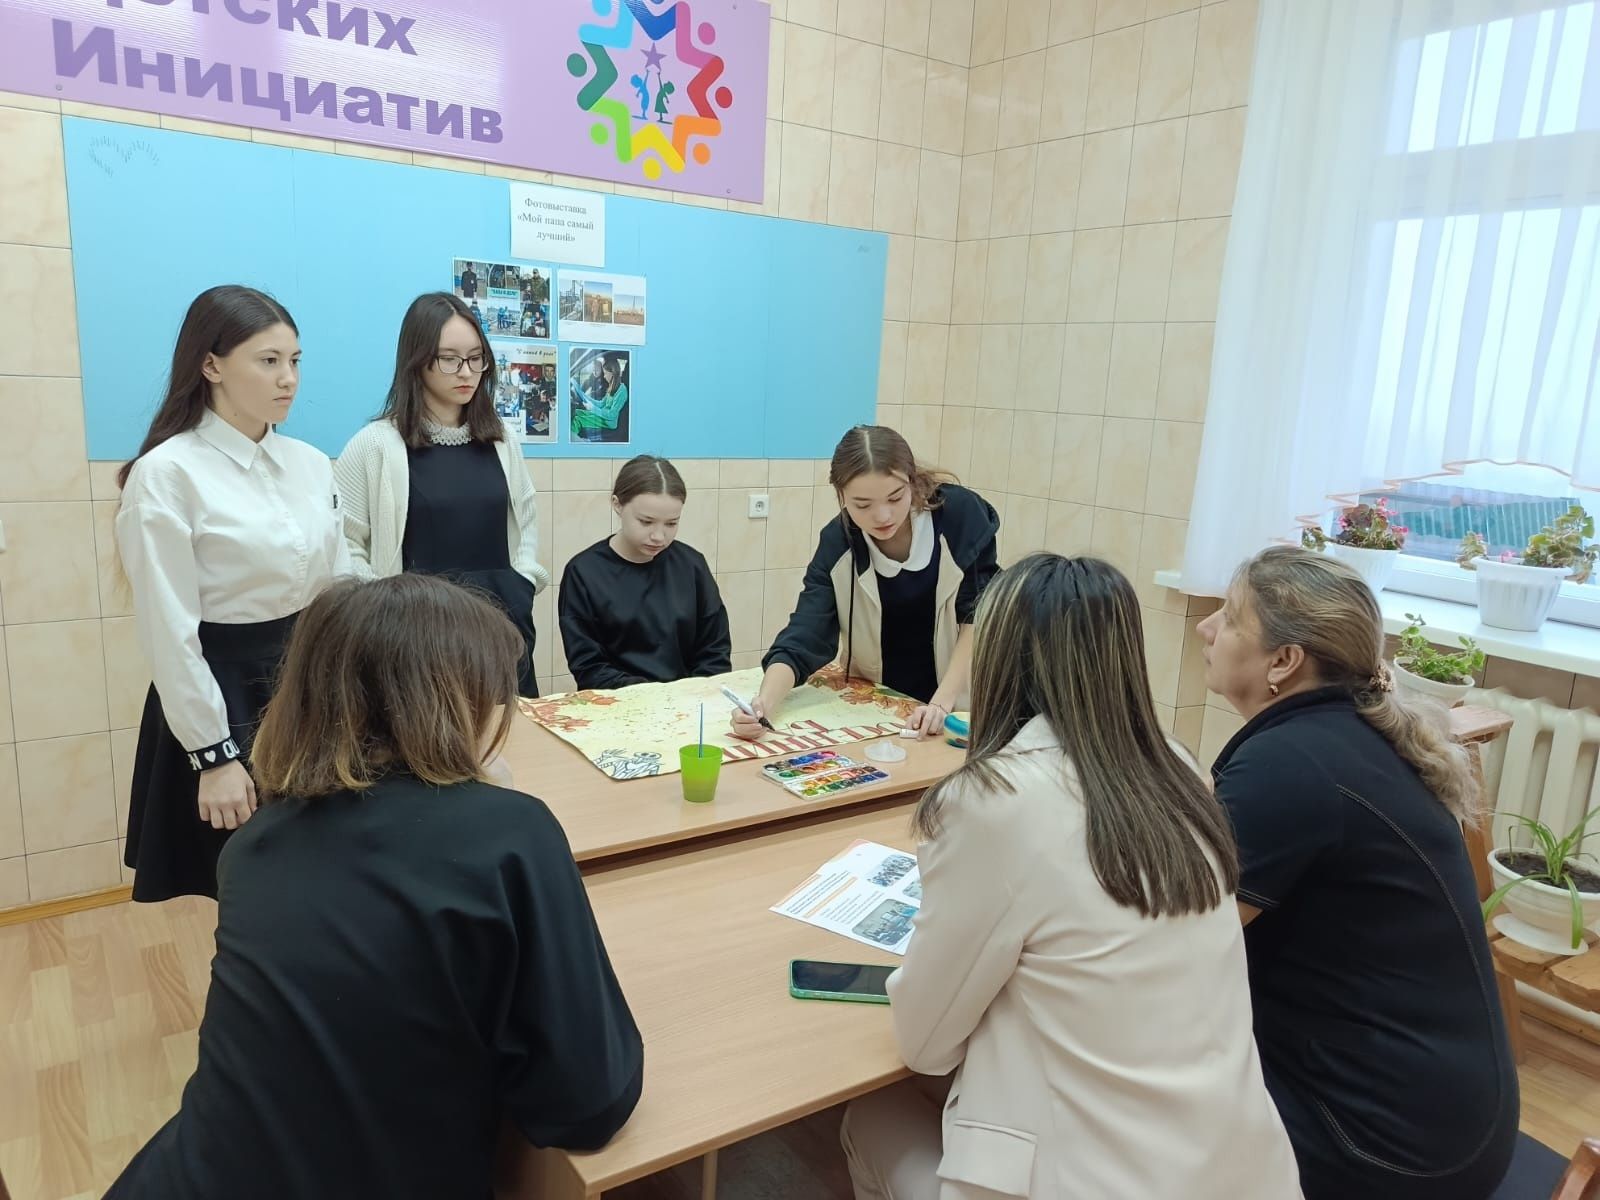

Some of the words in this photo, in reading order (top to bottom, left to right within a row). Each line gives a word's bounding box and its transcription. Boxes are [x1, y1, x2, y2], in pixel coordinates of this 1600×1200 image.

[106, 0, 418, 57] ских
[52, 18, 504, 145] Инициатив
[525, 197, 587, 214] Фотовыставка
[517, 212, 542, 223] «Мой
[545, 217, 565, 226] папа
[567, 220, 594, 230] самый
[536, 231, 576, 242] лучший»
